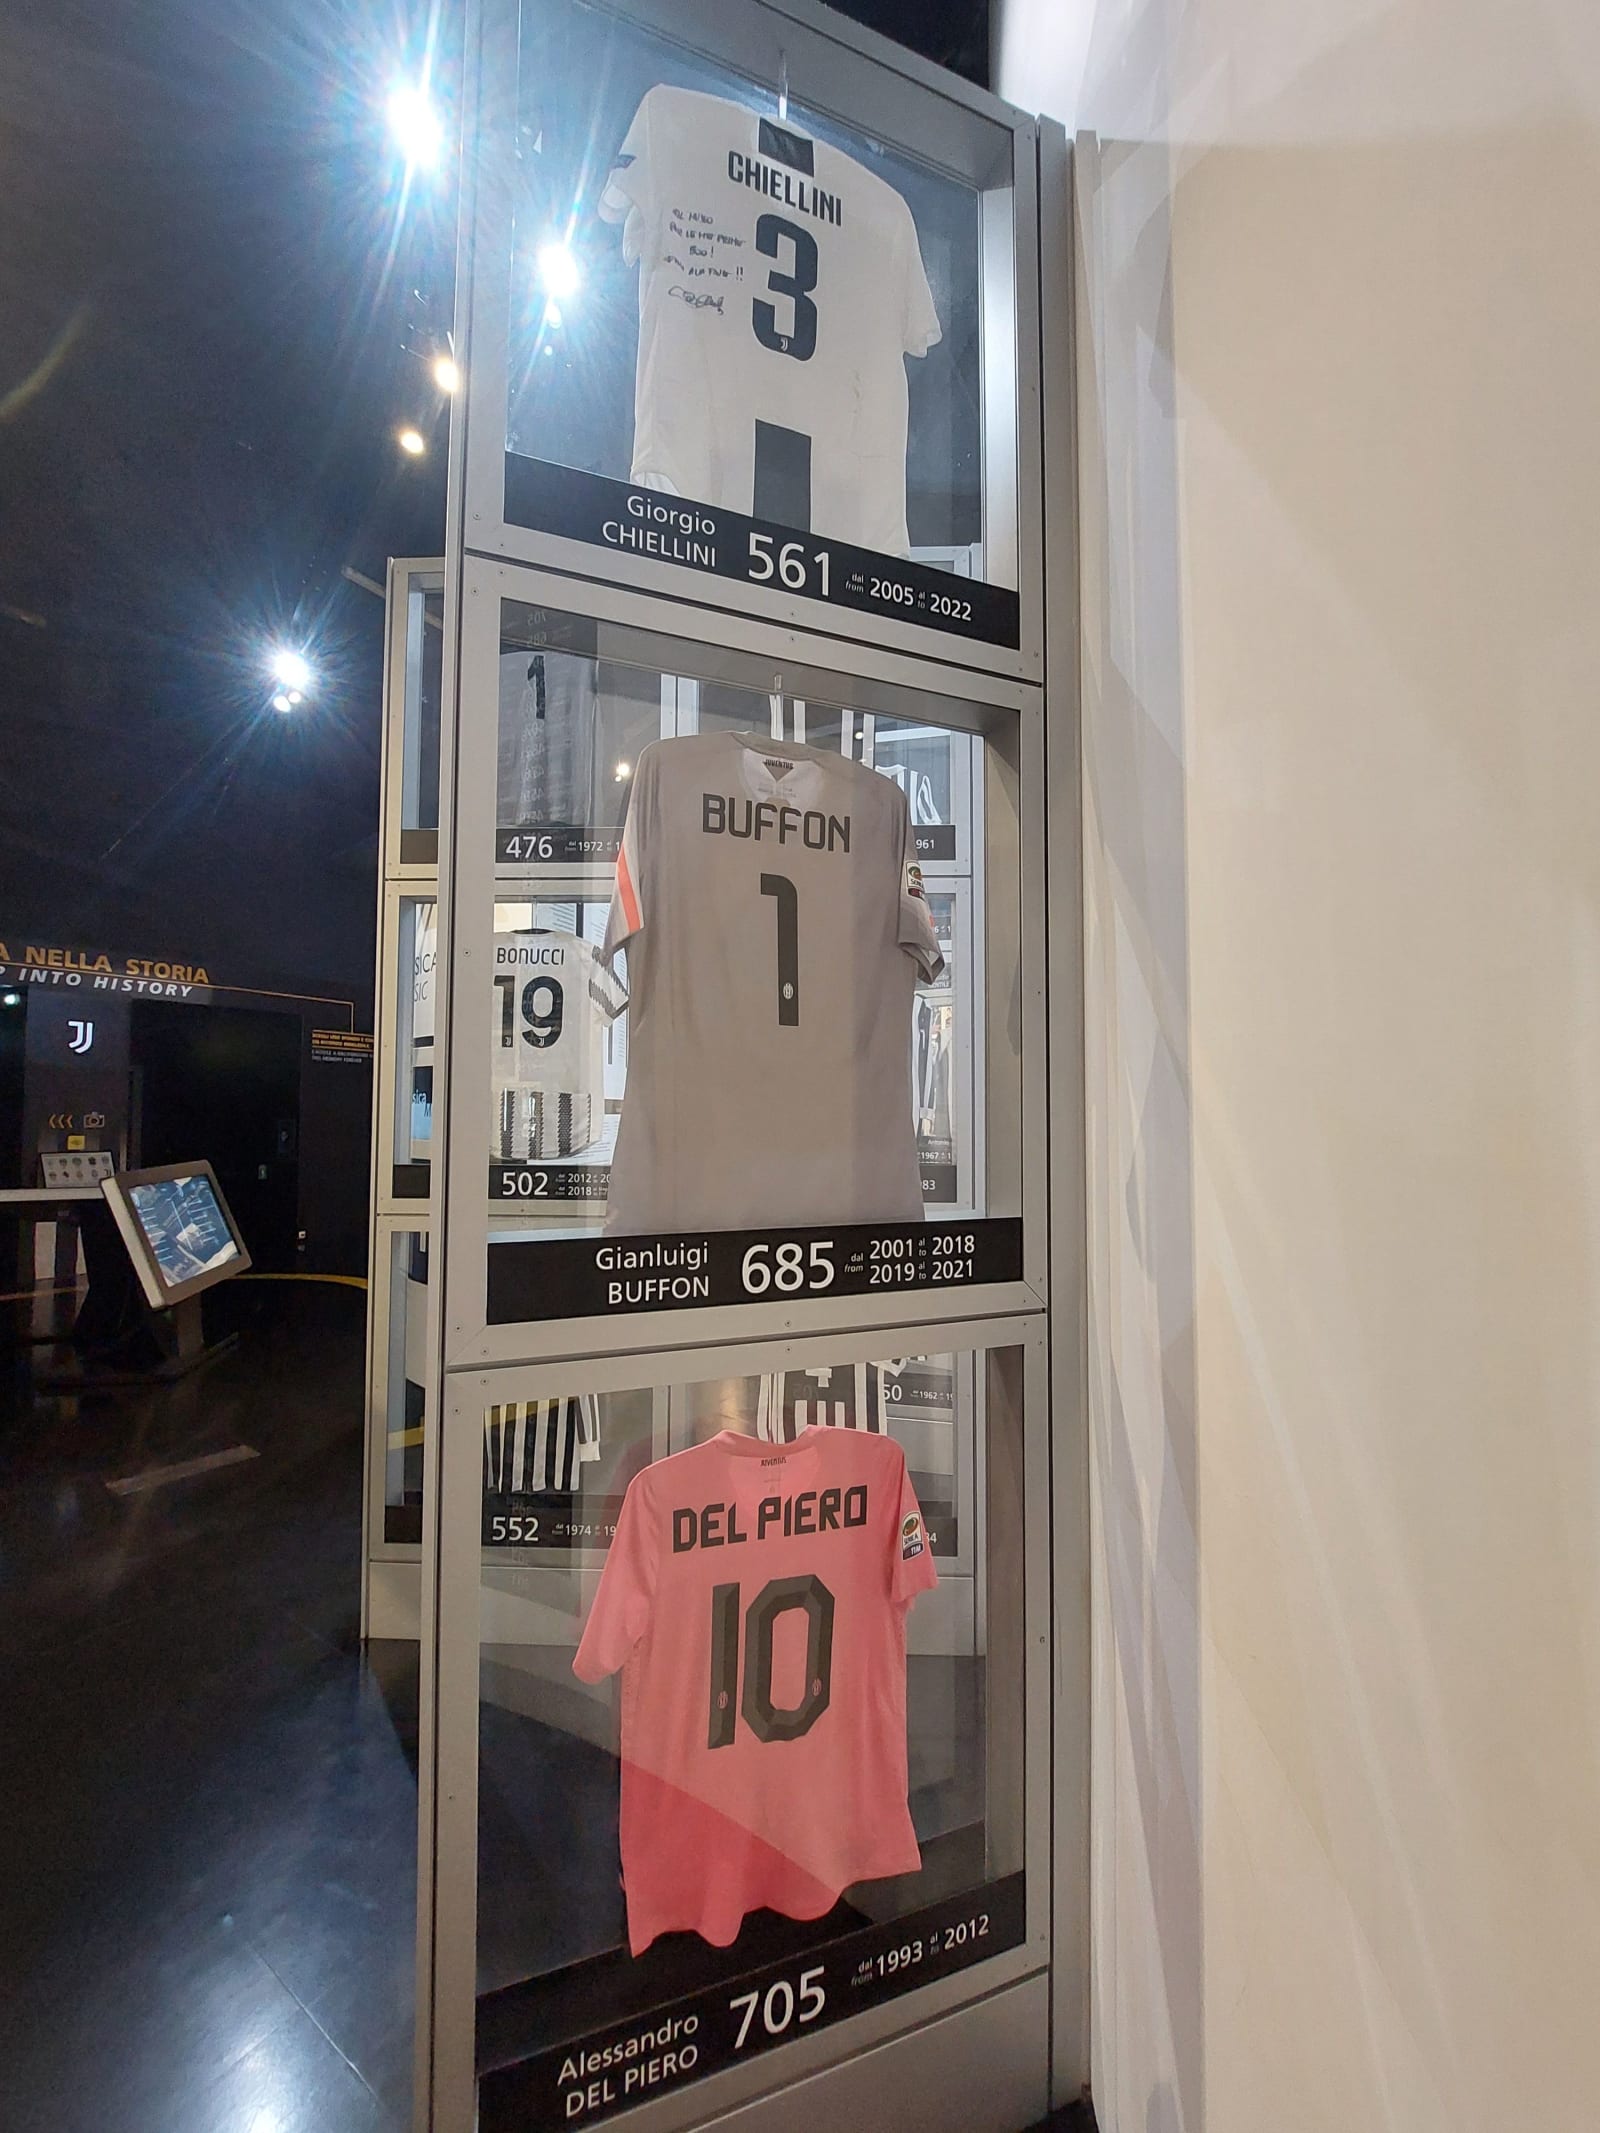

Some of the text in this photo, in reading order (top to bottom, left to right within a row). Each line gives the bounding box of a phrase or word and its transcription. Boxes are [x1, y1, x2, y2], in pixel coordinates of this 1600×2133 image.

[728, 150, 841, 227] CHIELLINI
[752, 213, 819, 361] 3
[626, 495, 716, 536] Giorgio
[602, 520, 716, 568] CHIELLINI
[748, 531, 829, 597] 561
[845, 580, 864, 593] from
[851, 572, 972, 622] dal 2005 al 2022
[702, 793, 851, 853] BUFFON
[505, 836, 553, 859] 476
[578, 841, 604, 852] 1972
[25, 945, 113, 973] NELLA
[126, 959, 209, 984] STORIA
[496, 947, 565, 966] BONUCCI
[760, 872, 800, 1027] 1
[18, 967, 82, 986] INTO
[93, 976, 193, 997] HISTORY
[493, 975, 564, 1048] 19
[502, 1172, 549, 1196] 502
[567, 1173, 592, 1183] 2012
[567, 1186, 592, 1196] 2018
[595, 1241, 709, 1271] Gianluigi
[850, 1252, 864, 1263] dal
[869, 1234, 975, 1259] 2001 al 2018
[918, 1249, 927, 1257] to
[741, 1241, 835, 1294] 685
[844, 1263, 864, 1273] from
[869, 1258, 973, 1284] 2019 al 2021
[918, 1272, 927, 1280] to
[608, 1275, 710, 1305] BUFFON
[919, 1390, 938, 1400] 1962
[491, 1516, 539, 1541] 552
[565, 1524, 592, 1536] 1974
[672, 1484, 868, 1553] DEL PIERO
[707, 1574, 835, 1750] 10
[858, 1913, 989, 1977] dal 1993 al 2012
[851, 1970, 873, 1986] from
[729, 1965, 826, 2050] 705
[557, 2015, 699, 2087] Alessandro
[566, 2045, 698, 2119] DEL PIERO
